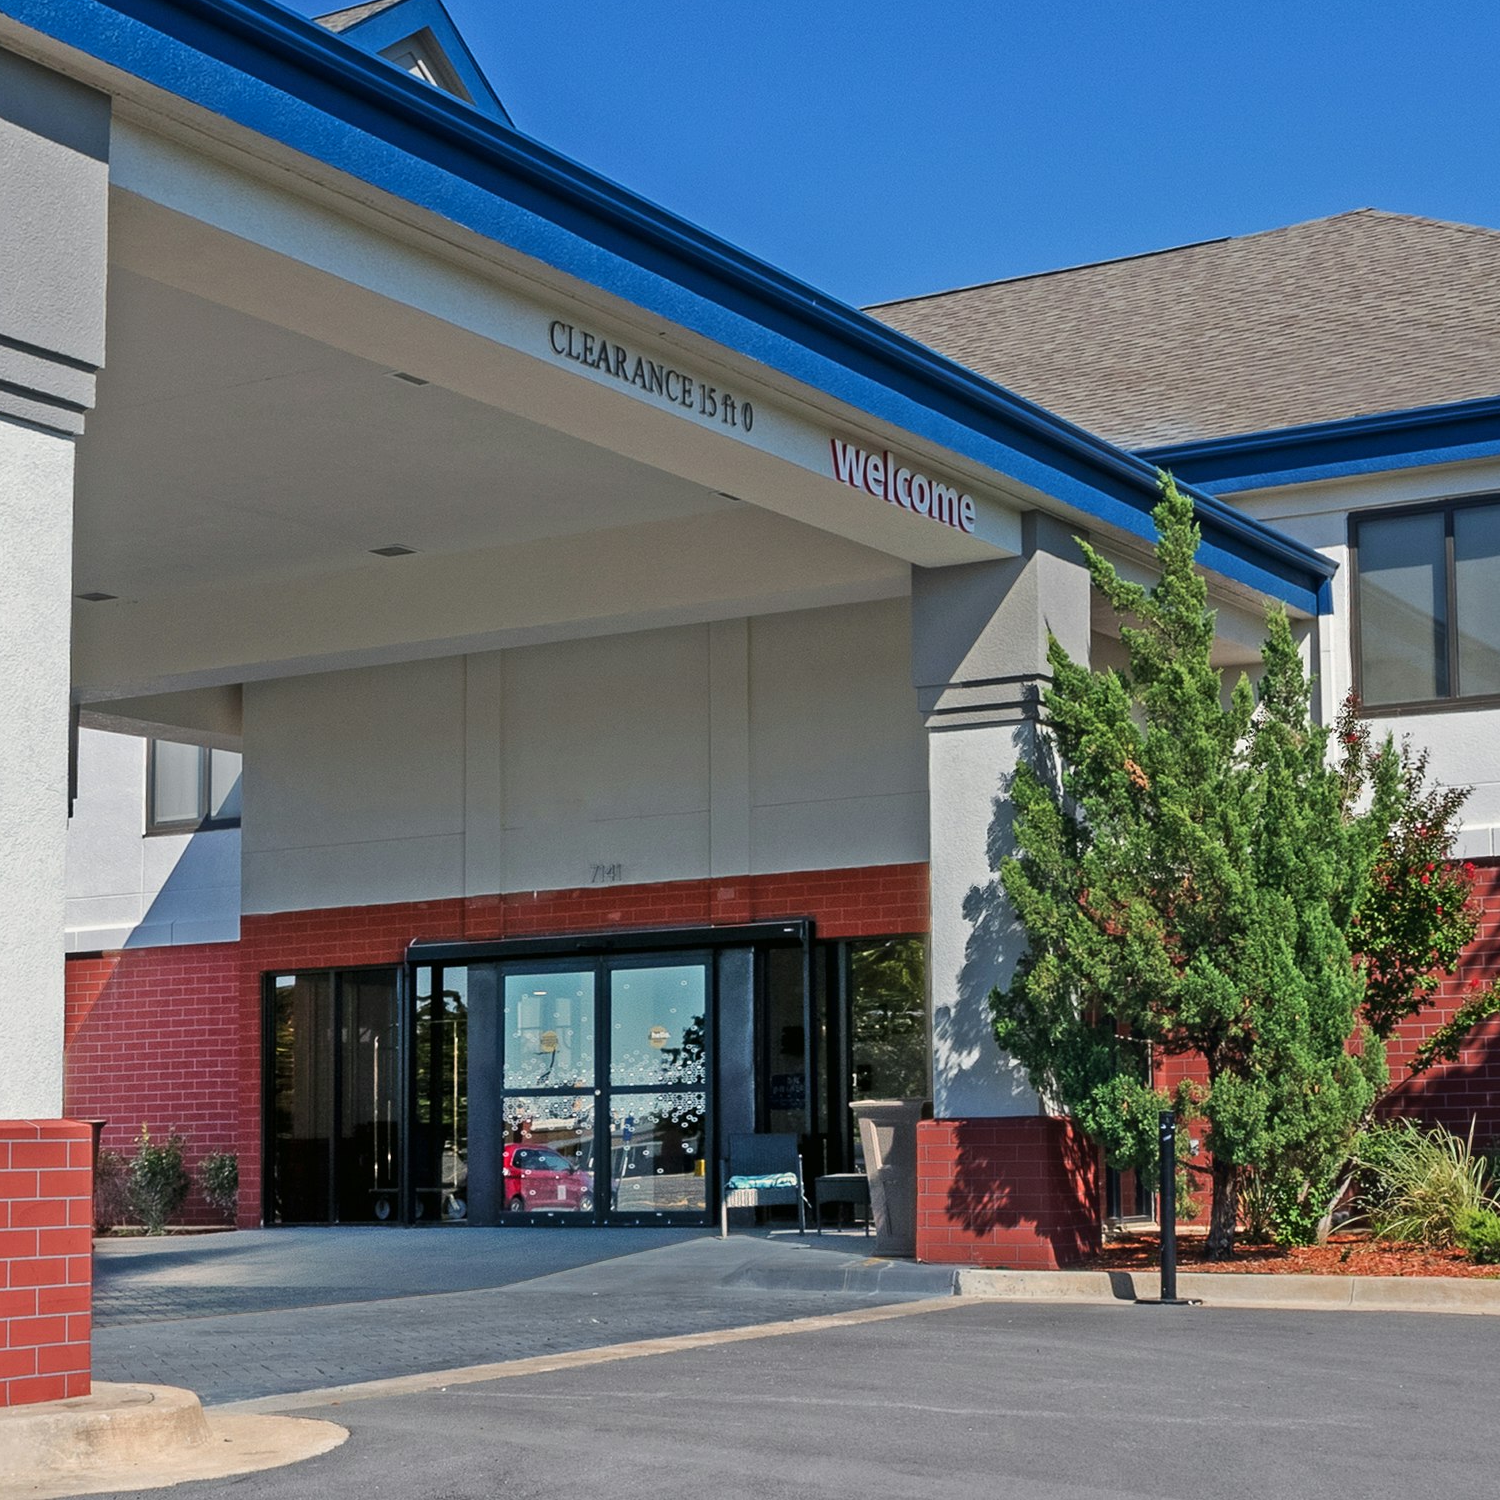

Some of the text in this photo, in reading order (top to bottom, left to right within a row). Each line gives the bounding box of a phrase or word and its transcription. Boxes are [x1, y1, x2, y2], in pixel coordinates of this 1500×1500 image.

[549, 320, 694, 409] CLEARANCE
[698, 384, 717, 418] 15
[720, 394, 737, 427] ft
[831, 438, 977, 534] welcome
[590, 863, 622, 884] 7141
